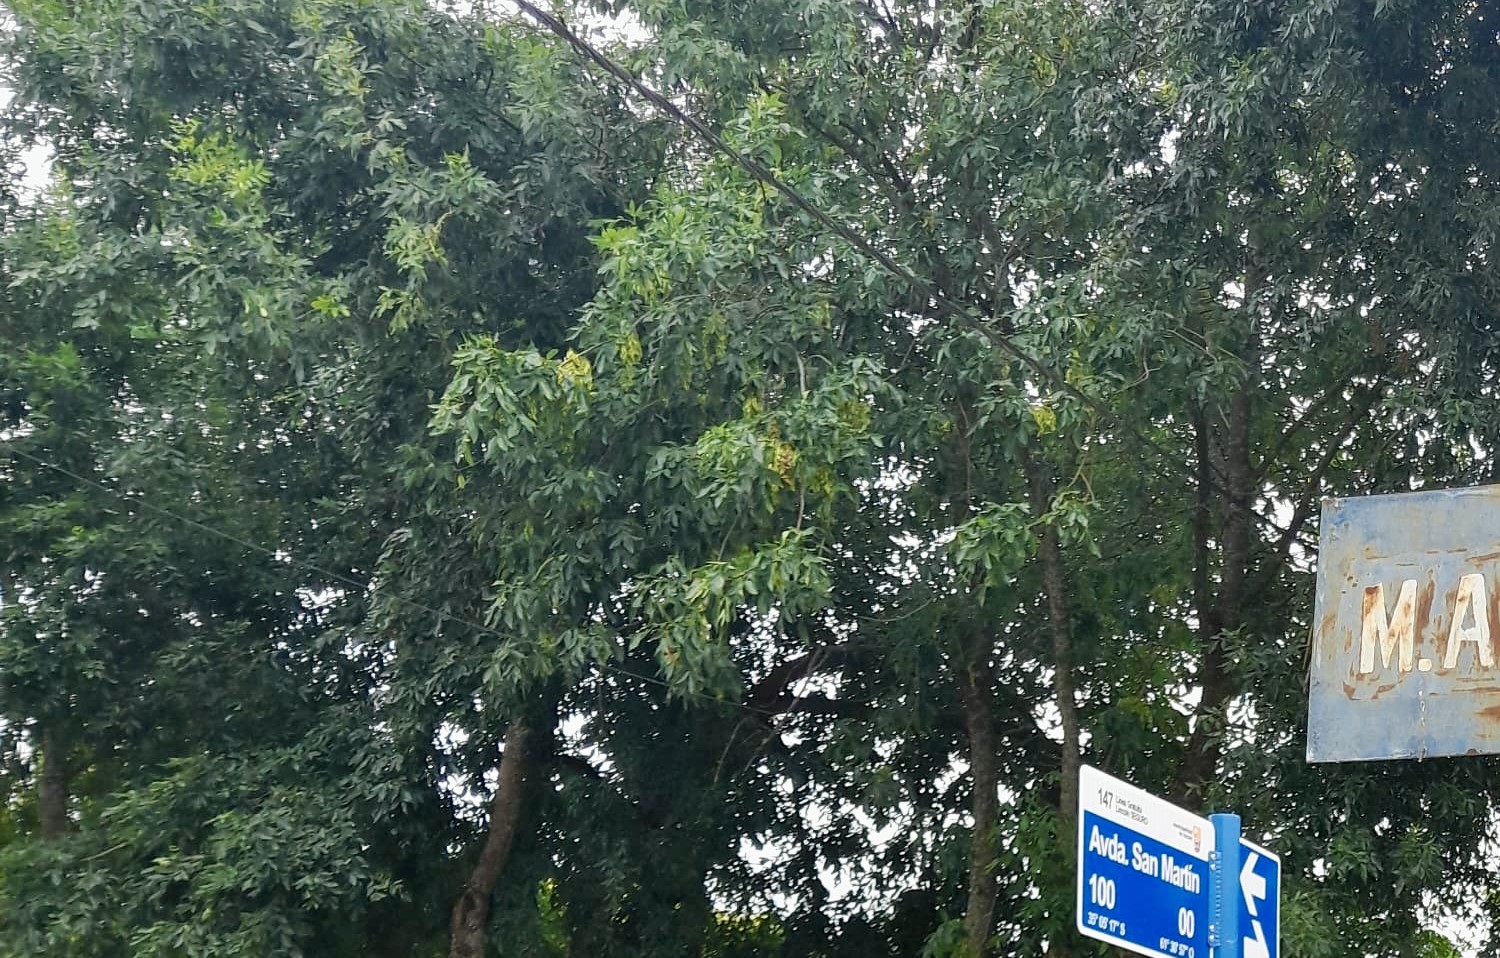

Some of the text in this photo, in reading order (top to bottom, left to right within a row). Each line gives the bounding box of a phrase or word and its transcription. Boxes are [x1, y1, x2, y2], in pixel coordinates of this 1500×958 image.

[1098, 788, 1114, 809] 147
[1088, 824, 1200, 894] Avda. San Martín
[1089, 873, 1116, 910] 100
[1178, 907, 1195, 938] 00
